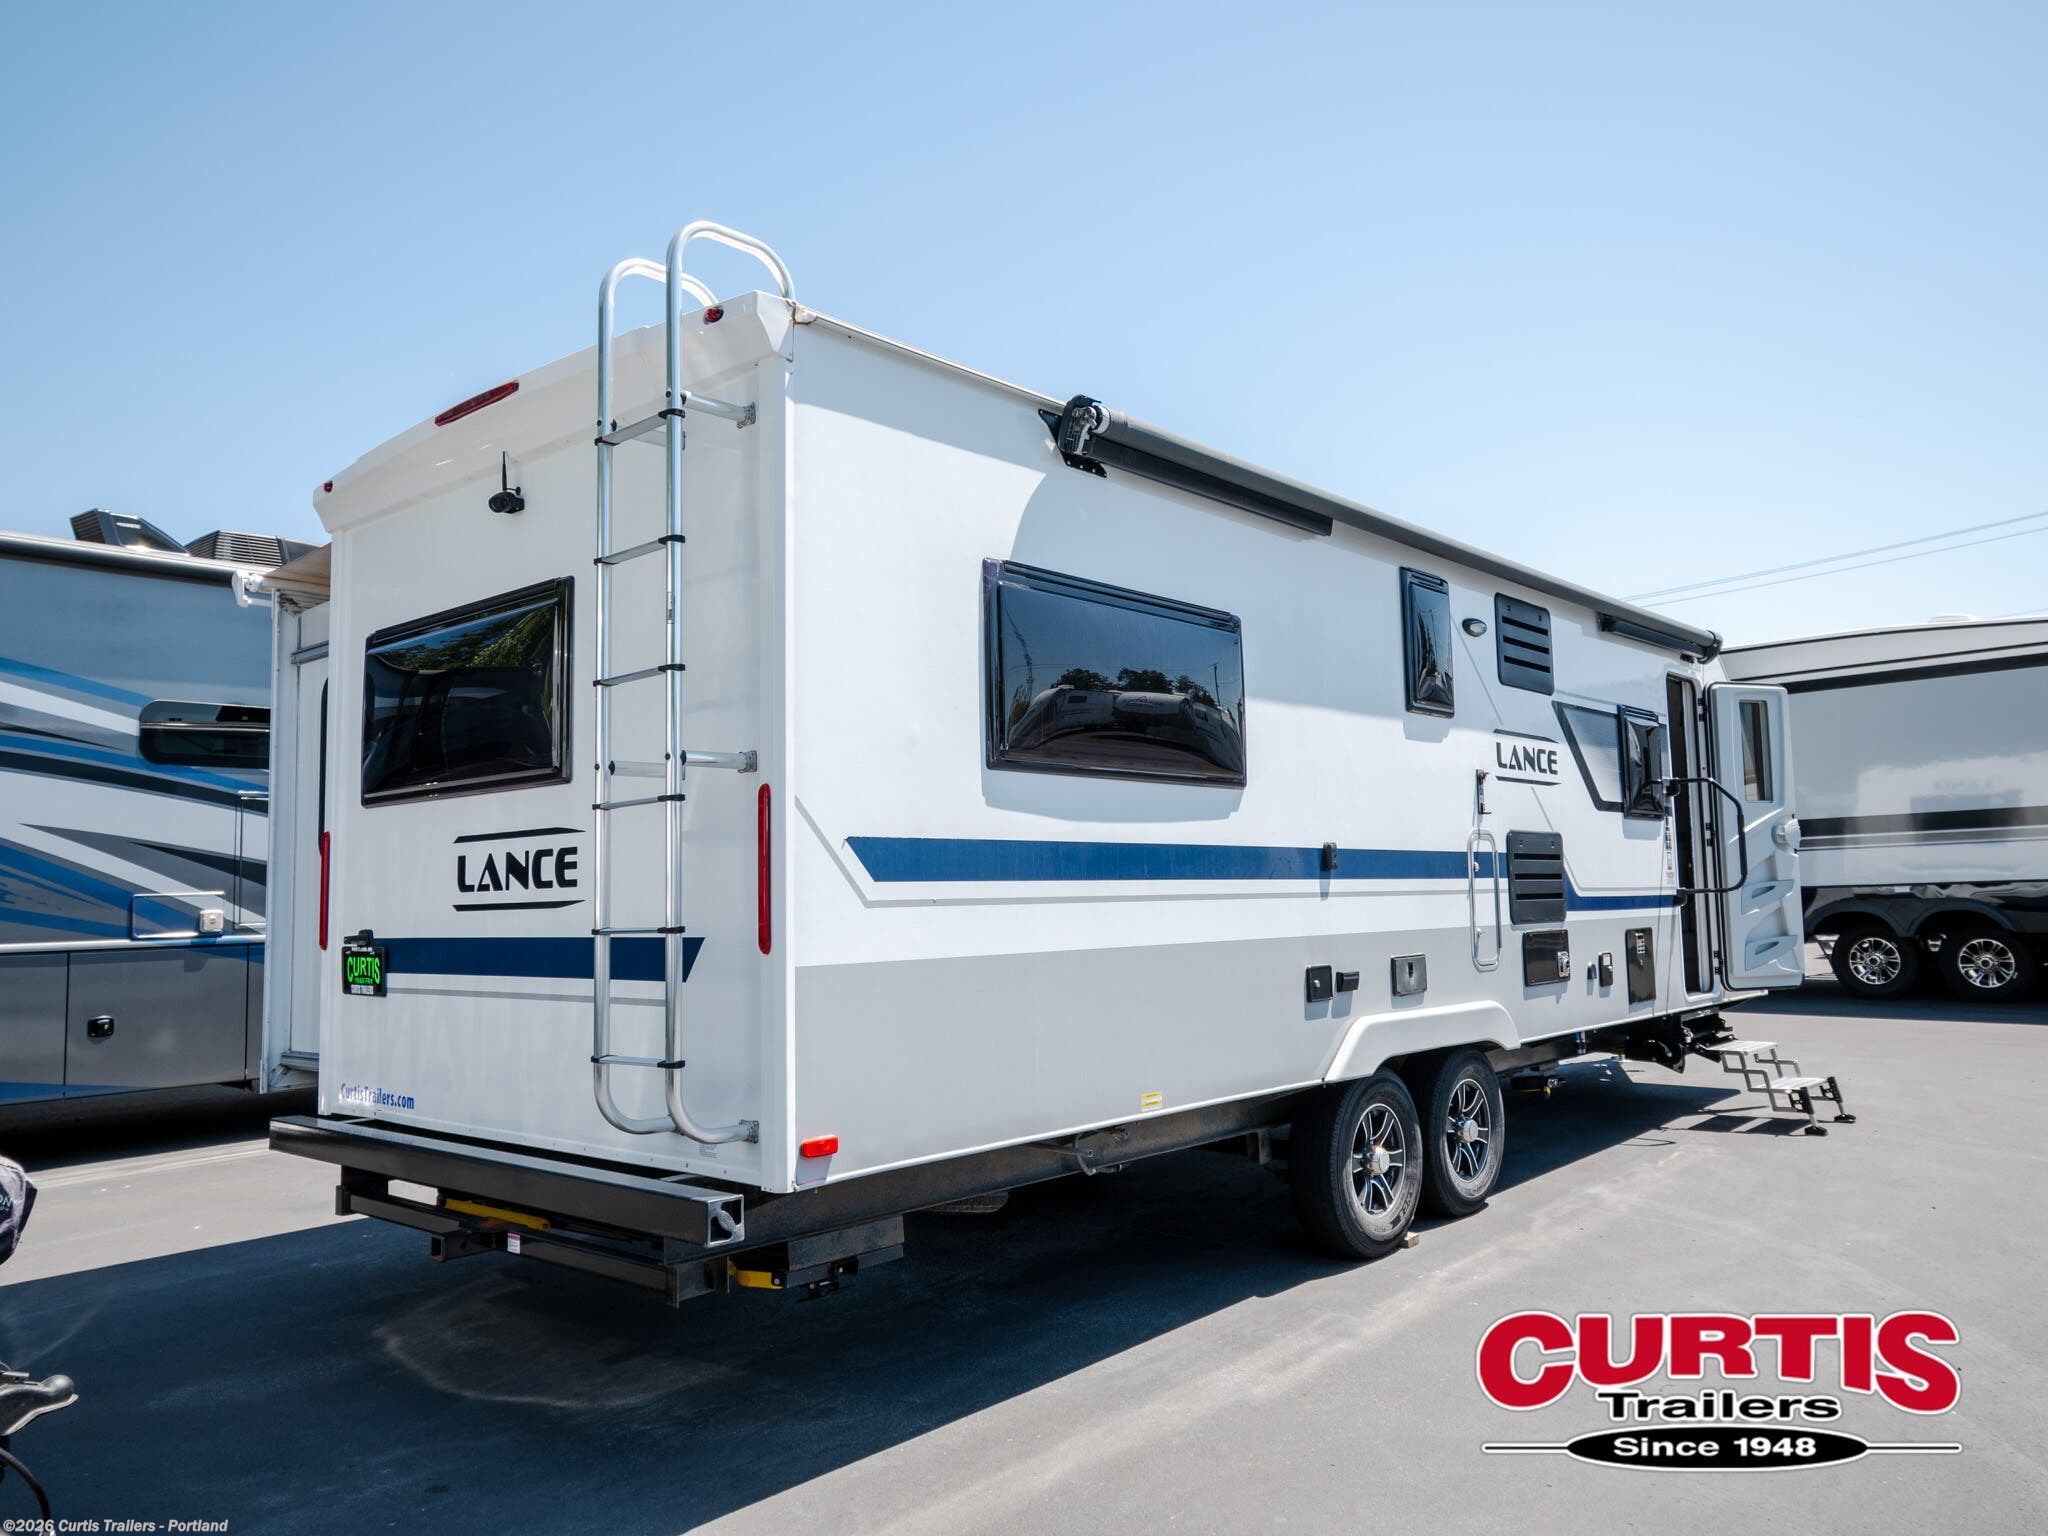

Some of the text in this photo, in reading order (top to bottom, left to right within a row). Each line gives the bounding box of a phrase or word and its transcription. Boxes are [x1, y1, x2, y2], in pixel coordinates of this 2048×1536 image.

[1496, 742, 1558, 775] LANCE
[457, 846, 578, 893] LANCE
[347, 956, 380, 985] CURTIS
[340, 1083, 415, 1110] CurtisTrailers.com
